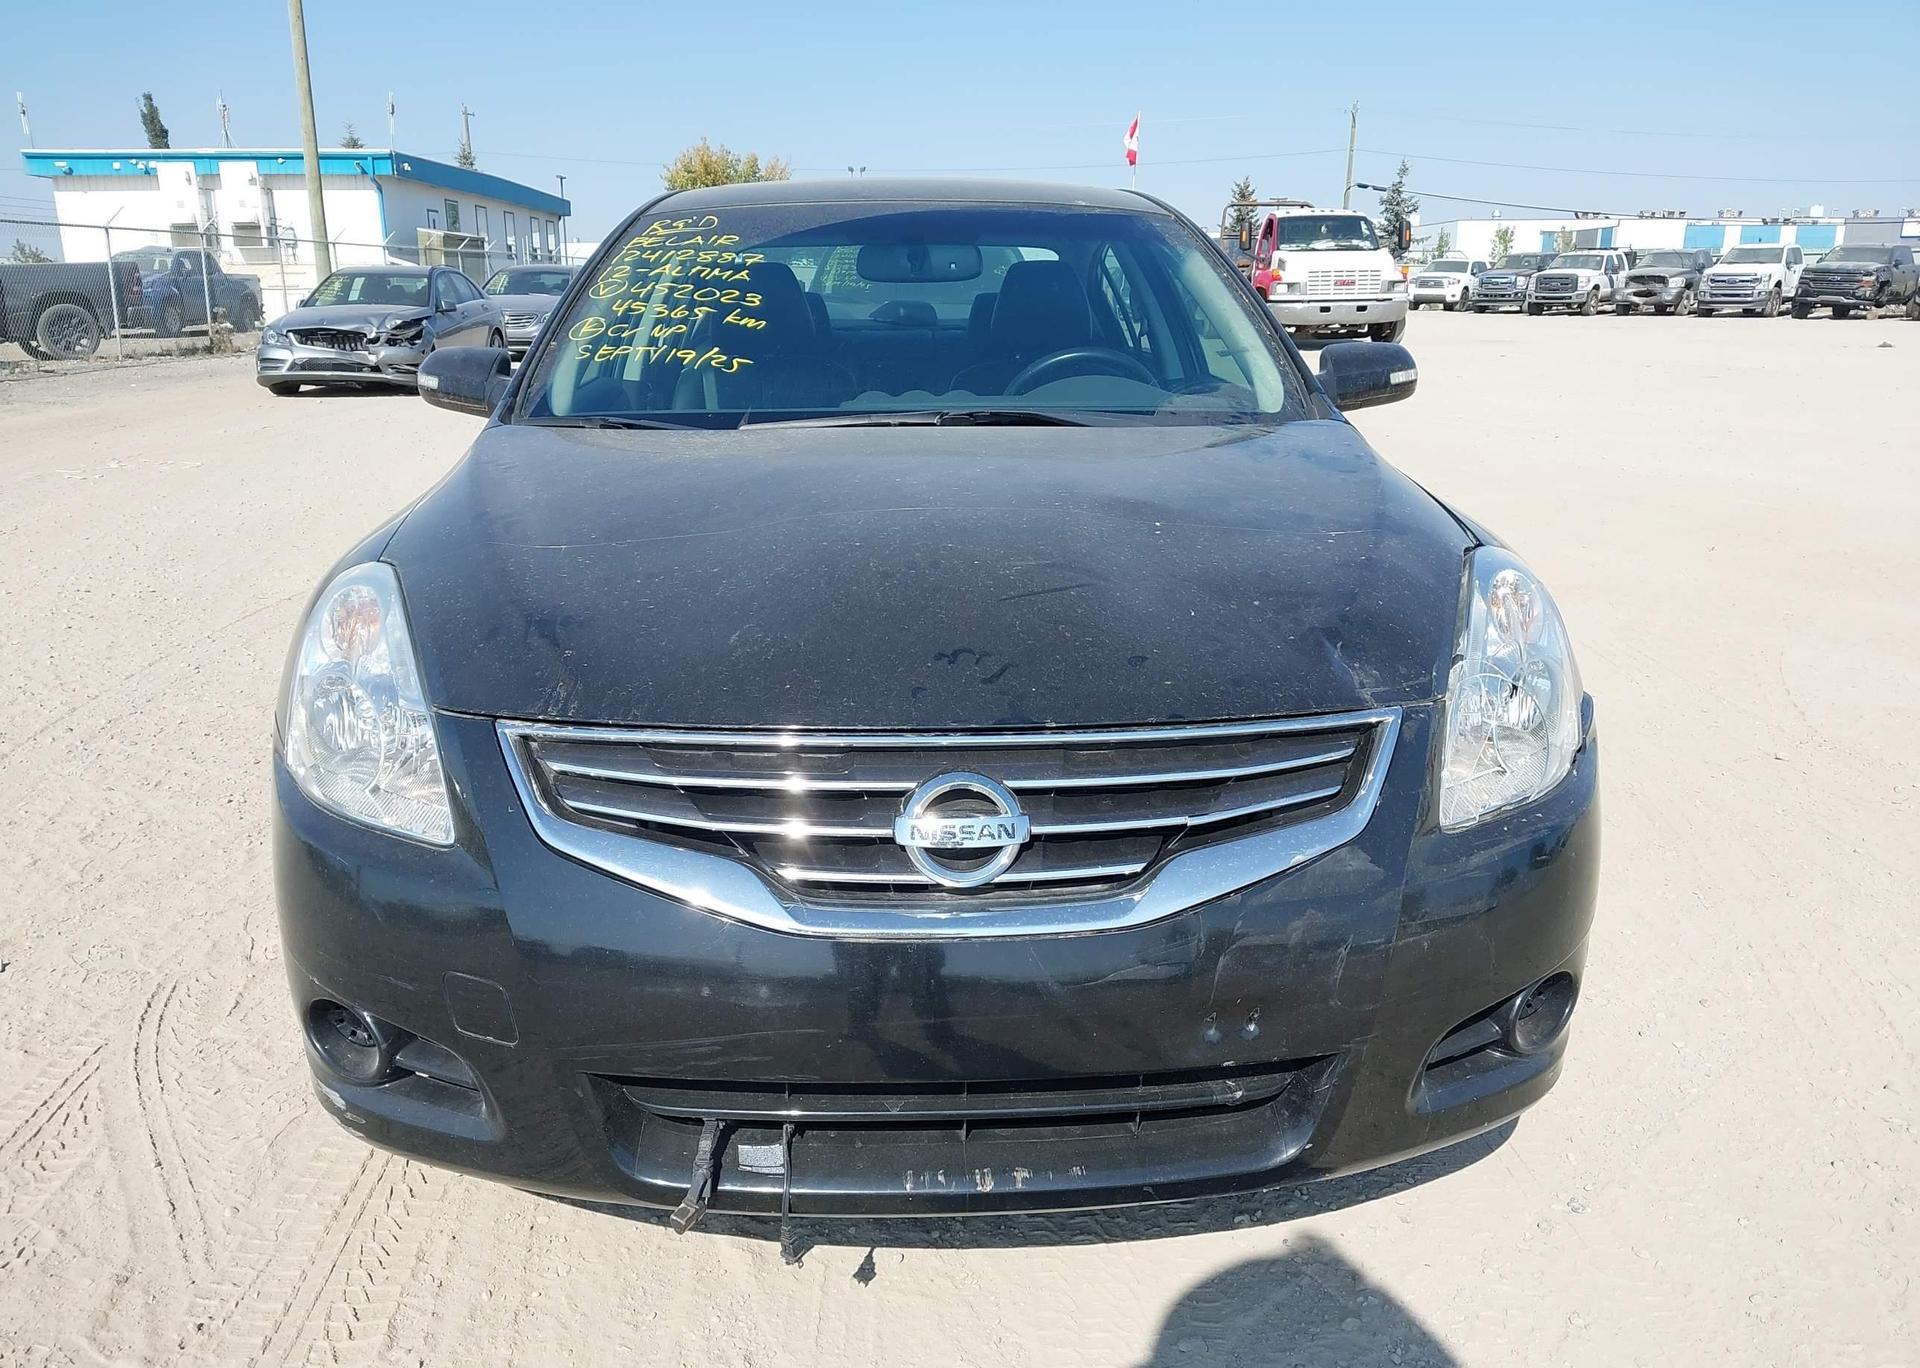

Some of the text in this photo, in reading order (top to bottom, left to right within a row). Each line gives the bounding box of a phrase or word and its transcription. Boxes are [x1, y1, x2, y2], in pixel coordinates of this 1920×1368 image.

[624, 234, 740, 250] BELAIR
[611, 249, 768, 267] 12412887
[630, 281, 763, 306] 452023
[611, 298, 718, 320] 45365
[910, 822, 1017, 842] NISSAN
